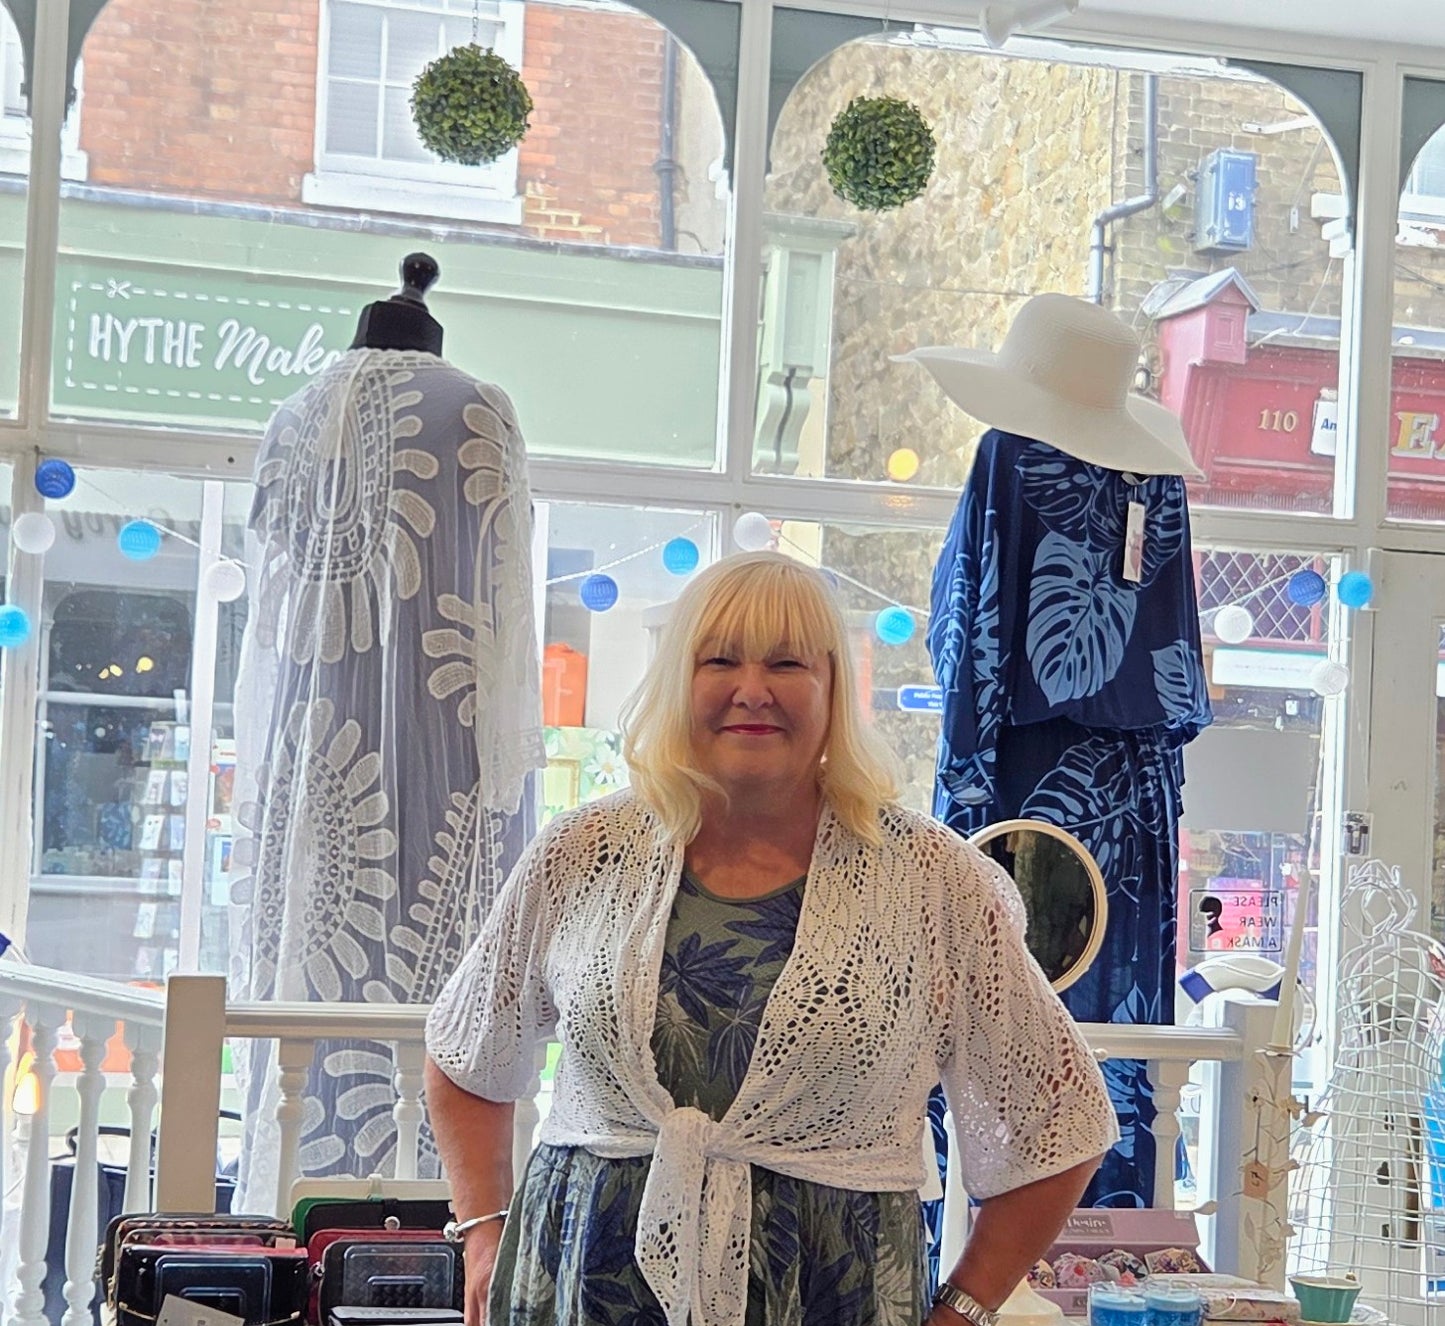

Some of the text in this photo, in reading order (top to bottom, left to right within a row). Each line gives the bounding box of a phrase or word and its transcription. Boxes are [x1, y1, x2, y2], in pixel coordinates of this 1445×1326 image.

[88, 312, 205, 369] HYTHE
[1257, 409, 1298, 432] 110
[1391, 411, 1445, 460] E
